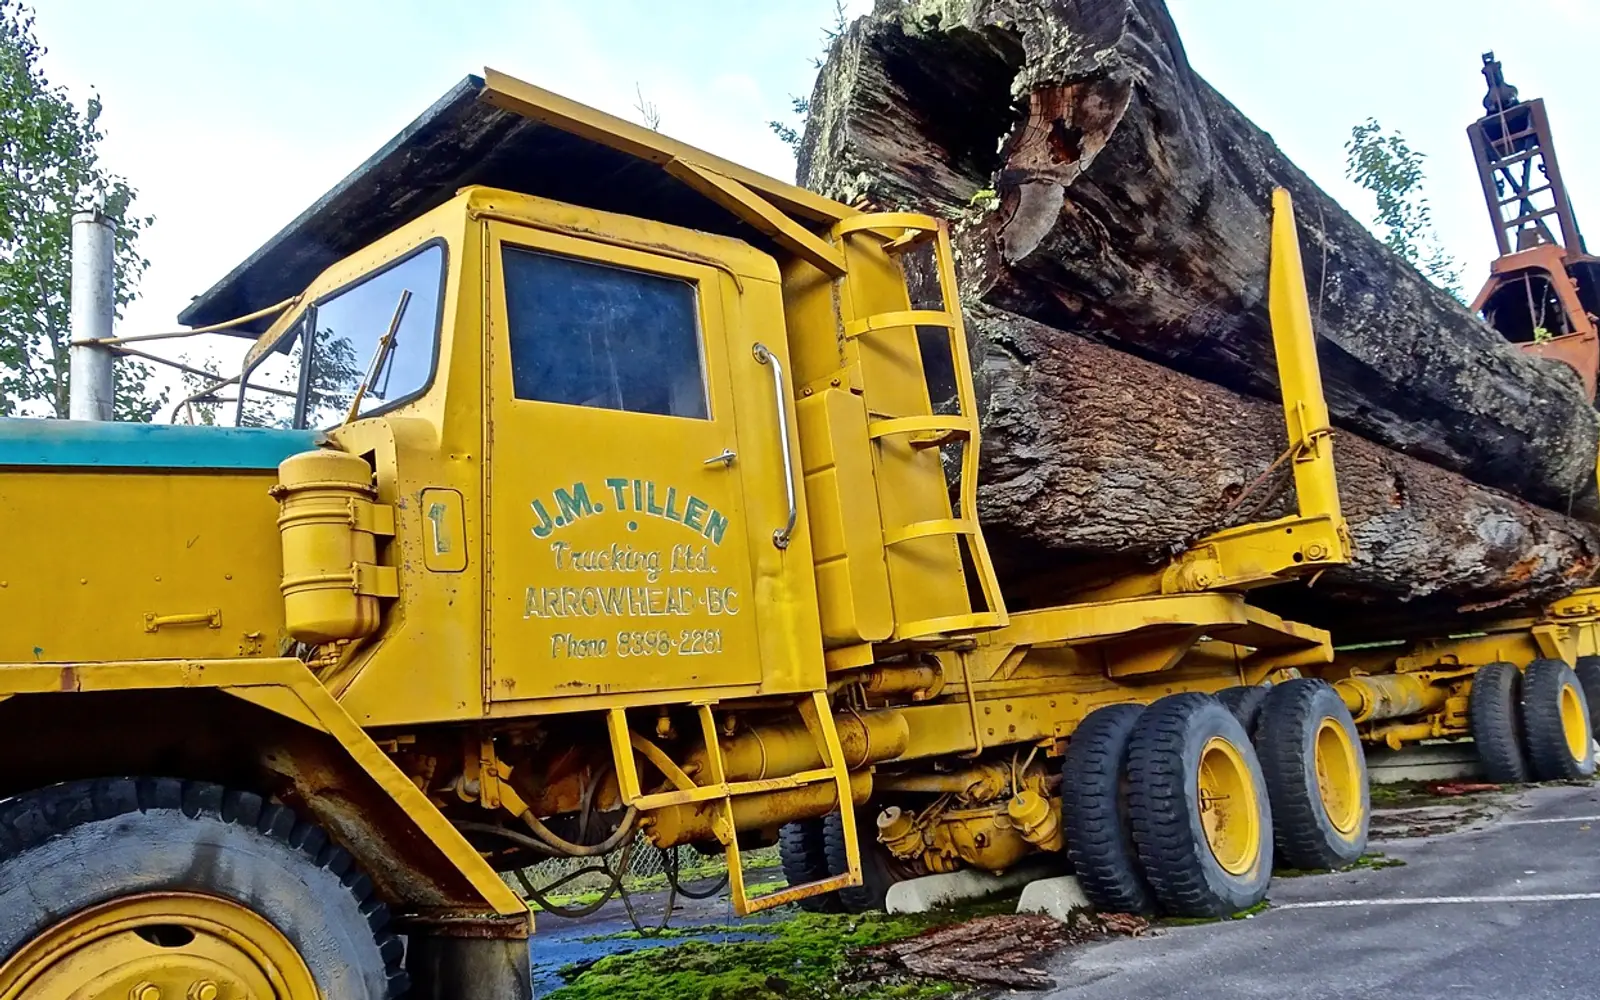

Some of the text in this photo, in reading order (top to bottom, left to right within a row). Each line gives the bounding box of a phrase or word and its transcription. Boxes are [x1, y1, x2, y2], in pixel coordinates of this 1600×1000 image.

[428, 502, 452, 556] 1
[530, 478, 729, 546] J.M. TILLEN
[551, 541, 718, 583] Trucking Ltd.
[550, 632, 608, 659] Phone
